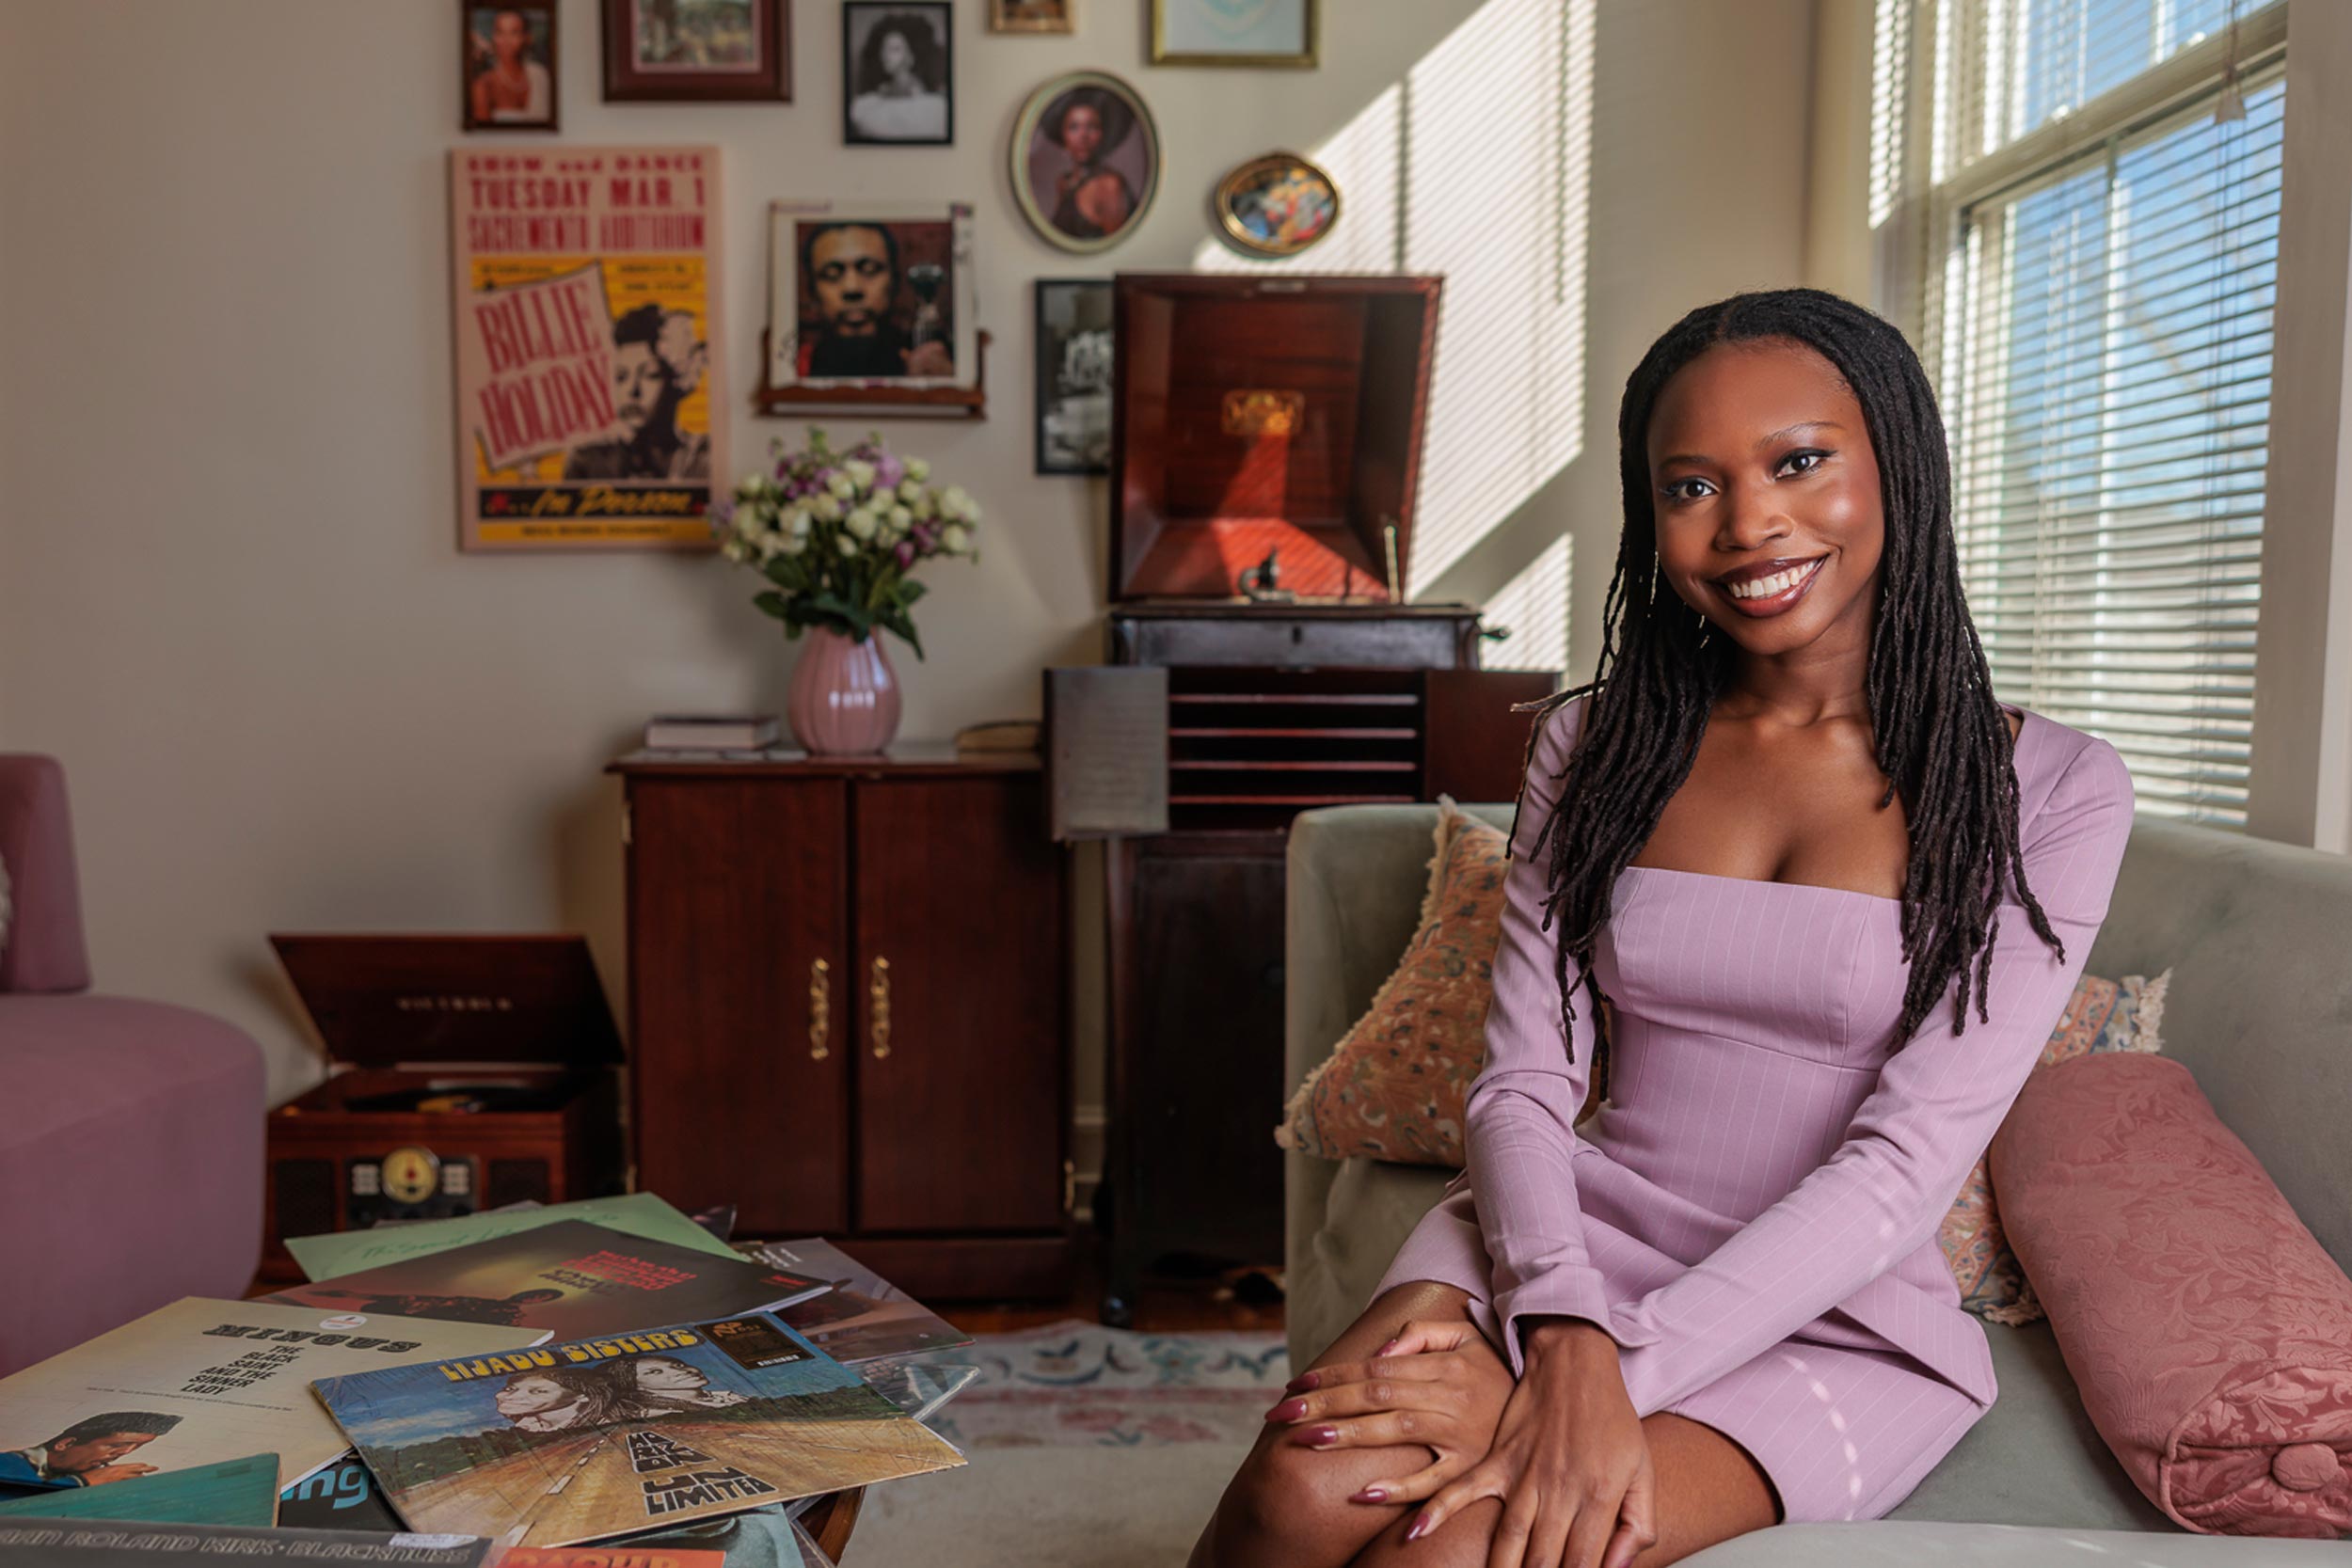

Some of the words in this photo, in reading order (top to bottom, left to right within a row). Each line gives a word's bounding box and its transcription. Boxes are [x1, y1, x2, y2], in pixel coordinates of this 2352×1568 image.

[472, 177, 590, 210] TUESDAY
[476, 280, 602, 373] BILLIE
[479, 354, 617, 457] HOLIDAY
[202, 1324, 422, 1353] MINGUS
[269, 1345, 305, 1354] THE
[228, 1360, 283, 1370] SAINT
[242, 1352, 300, 1363] BLACK
[438, 1349, 557, 1383] LIJADU
[561, 1329, 702, 1363] SISTERS
[188, 1375, 256, 1387] SINNER
[199, 1367, 242, 1376] AND
[240, 1370, 278, 1380] THE
[181, 1384, 231, 1395] LADY
[641, 1466, 754, 1494] UN
[645, 1476, 779, 1516] LIMITED
[63, 1531, 199, 1551] ROLAND
[199, 1536, 280, 1555] KIRK
